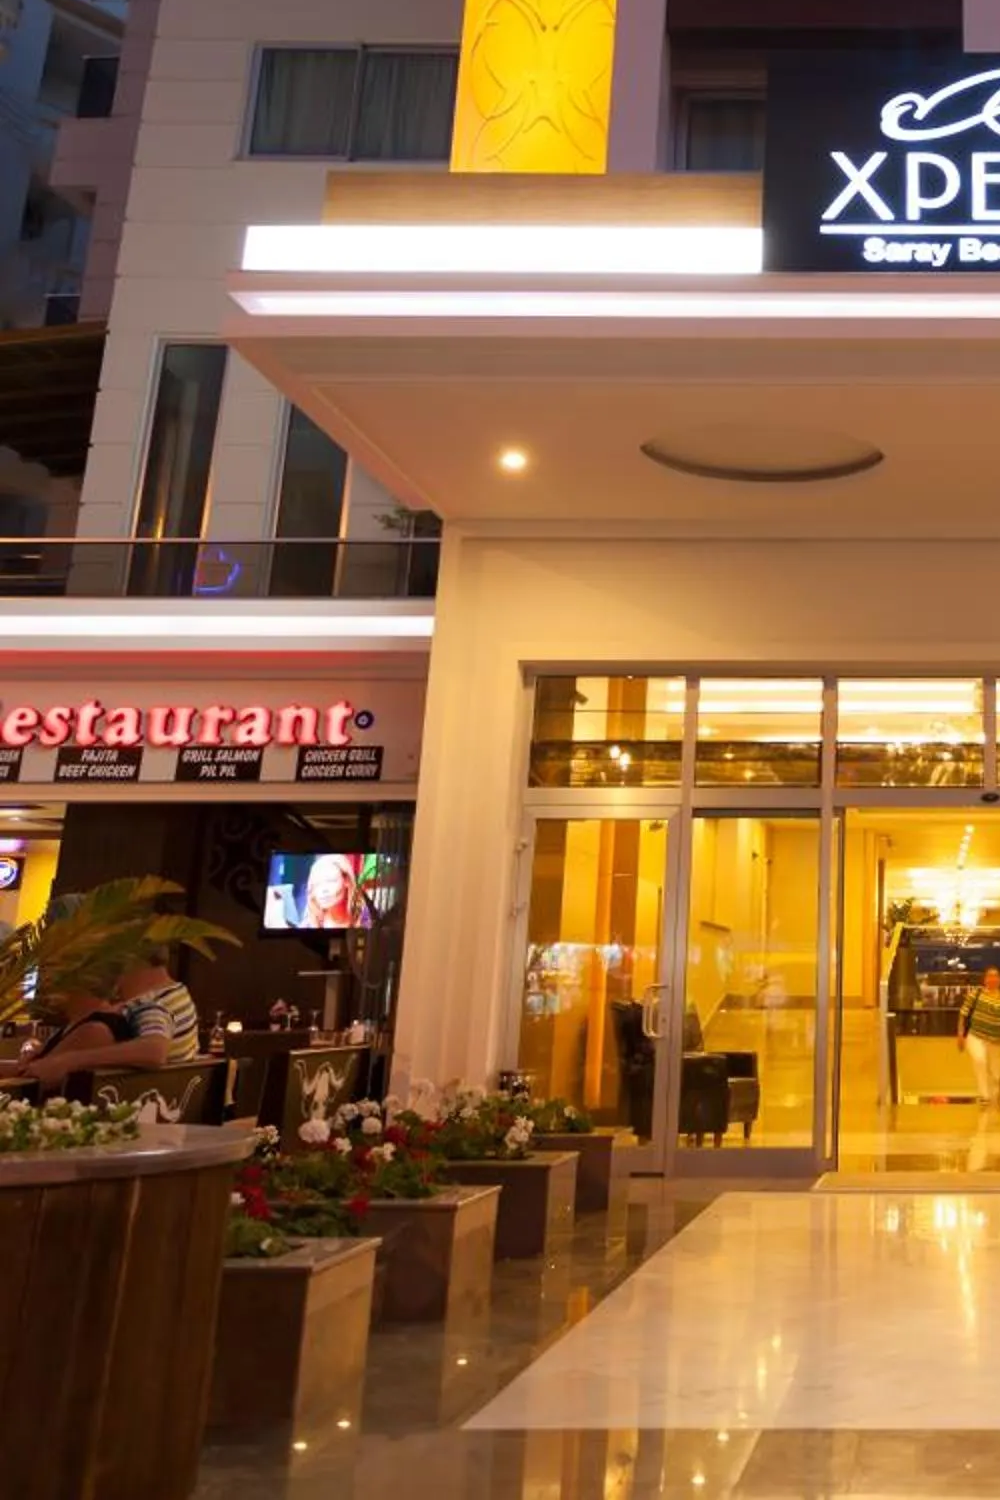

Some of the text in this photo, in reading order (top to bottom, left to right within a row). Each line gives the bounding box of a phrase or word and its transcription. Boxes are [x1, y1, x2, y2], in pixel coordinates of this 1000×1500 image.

[862, 237, 952, 267] Saray
[1, 700, 354, 746] estaurant
[214, 750, 260, 763] SALMON
[304, 750, 348, 763] CHICKEN
[58, 764, 136, 778] BEEF CHICKEN
[301, 764, 344, 778] CHICKEN
